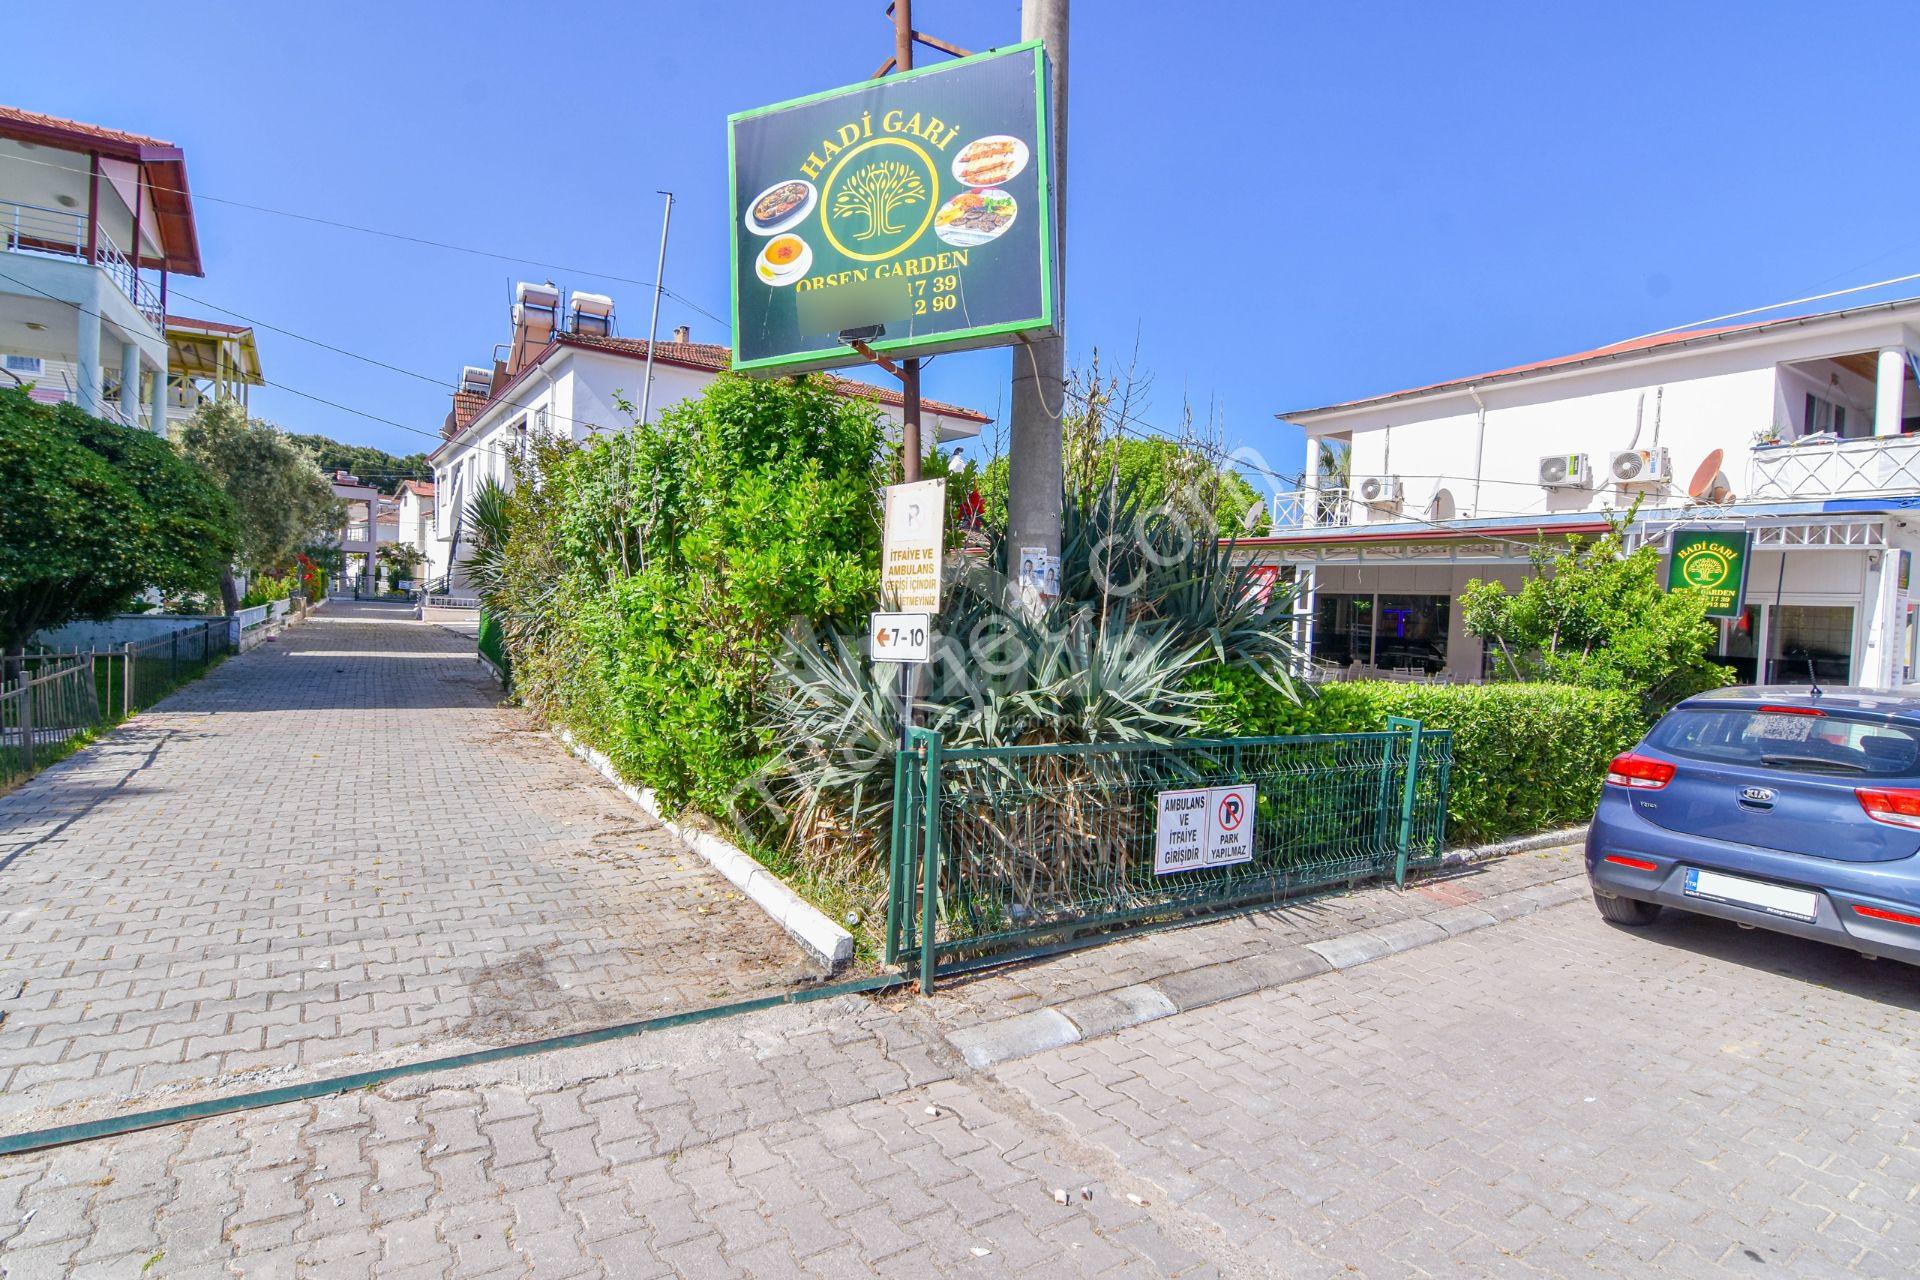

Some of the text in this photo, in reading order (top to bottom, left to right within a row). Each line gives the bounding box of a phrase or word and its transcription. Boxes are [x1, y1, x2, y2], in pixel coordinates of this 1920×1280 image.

[800, 110, 961, 181] HADİ GARİ
[875, 249, 969, 278] GARDEN
[932, 275, 957, 293] 39
[912, 295, 957, 316] 2 90
[890, 547, 933, 561] İTFAİYE VE
[1678, 541, 1738, 560] HADİ GARİ
[888, 563, 934, 576] AMBULANS
[891, 628, 925, 647] 7-10
[1745, 789, 1769, 799] KIA
[1164, 796, 1205, 812] AMBULANS
[1179, 813, 1189, 826] VE
[1169, 828, 1197, 844] İTFAİYE
[1219, 833, 1239, 845] PARK
[1211, 845, 1247, 860] YAPILMAZ
